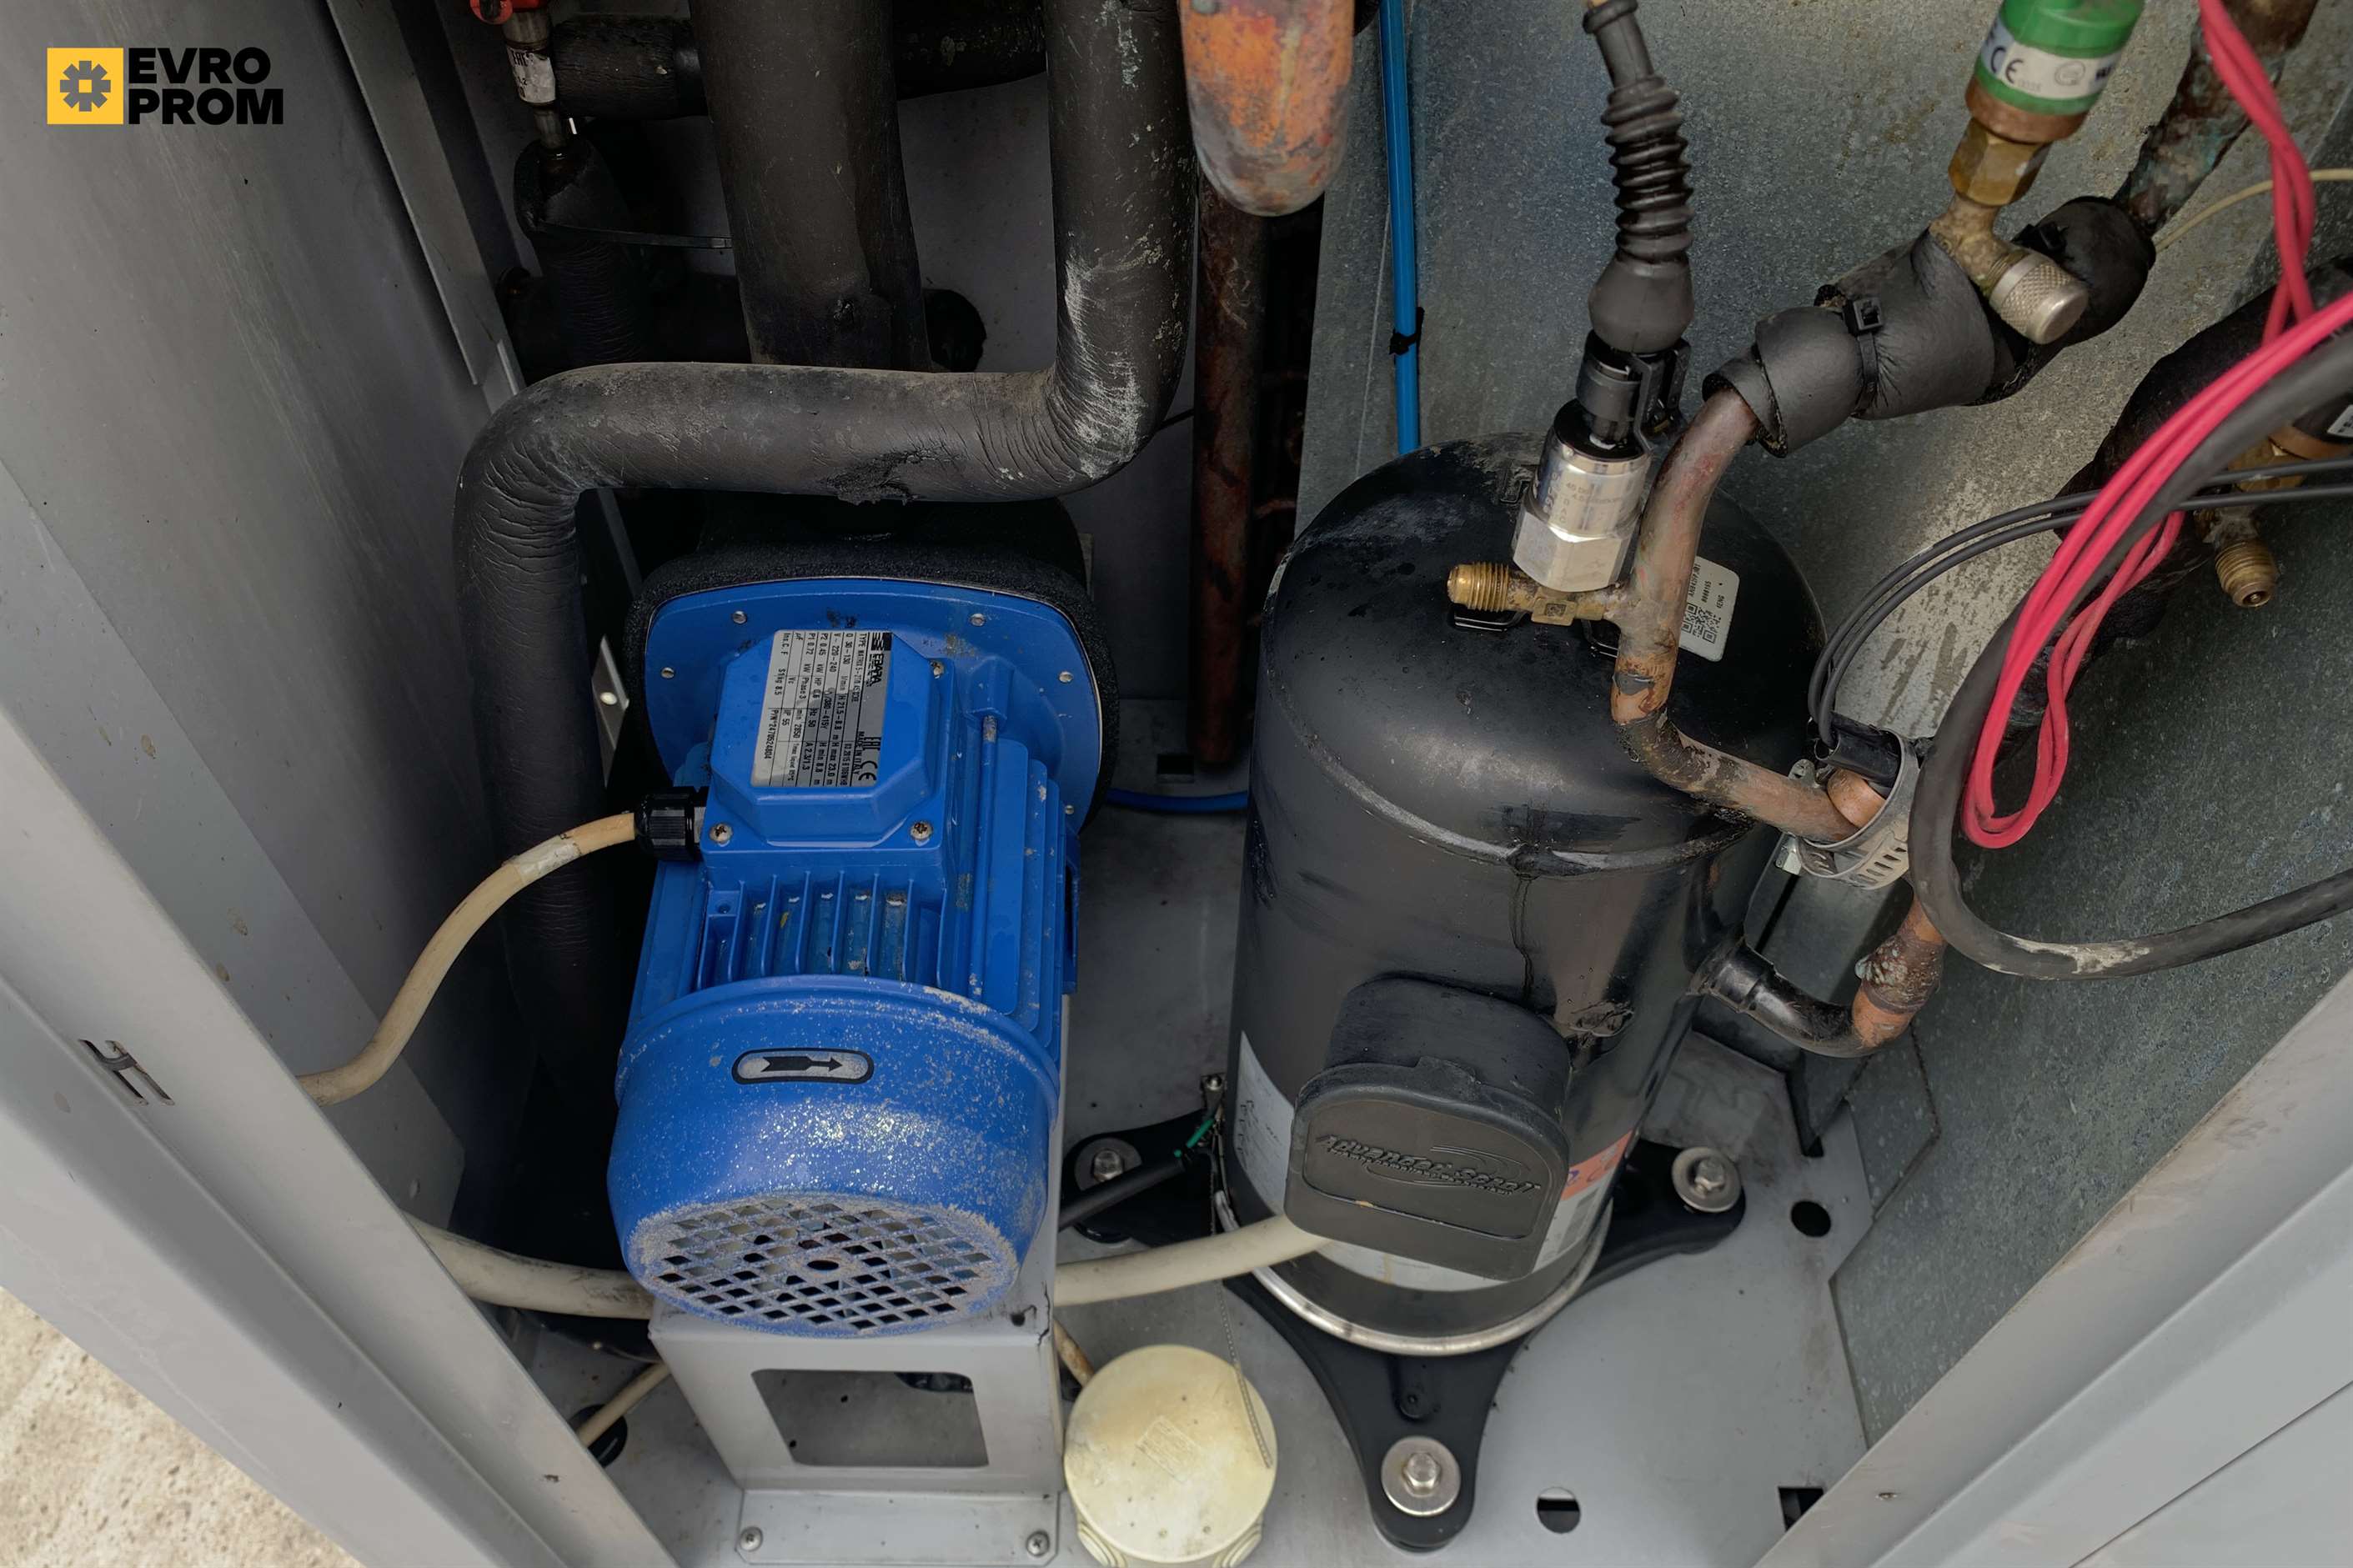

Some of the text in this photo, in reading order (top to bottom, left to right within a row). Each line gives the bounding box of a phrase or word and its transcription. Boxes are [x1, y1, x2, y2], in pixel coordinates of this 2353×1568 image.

[858, 633, 866, 647] TYPE
[805, 642, 814, 654] 0.72
[818, 643, 826, 655] 0.45
[829, 645, 839, 672] 220-240
[802, 664, 810, 672] kW
[815, 664, 823, 673] kW
[870, 654, 884, 686] EBARA
[799, 677, 809, 694] Phase
[814, 677, 821, 685] HP
[774, 685, 782, 695] 8.5
[855, 731, 864, 747] MADE
[852, 758, 860, 774] ITALY
